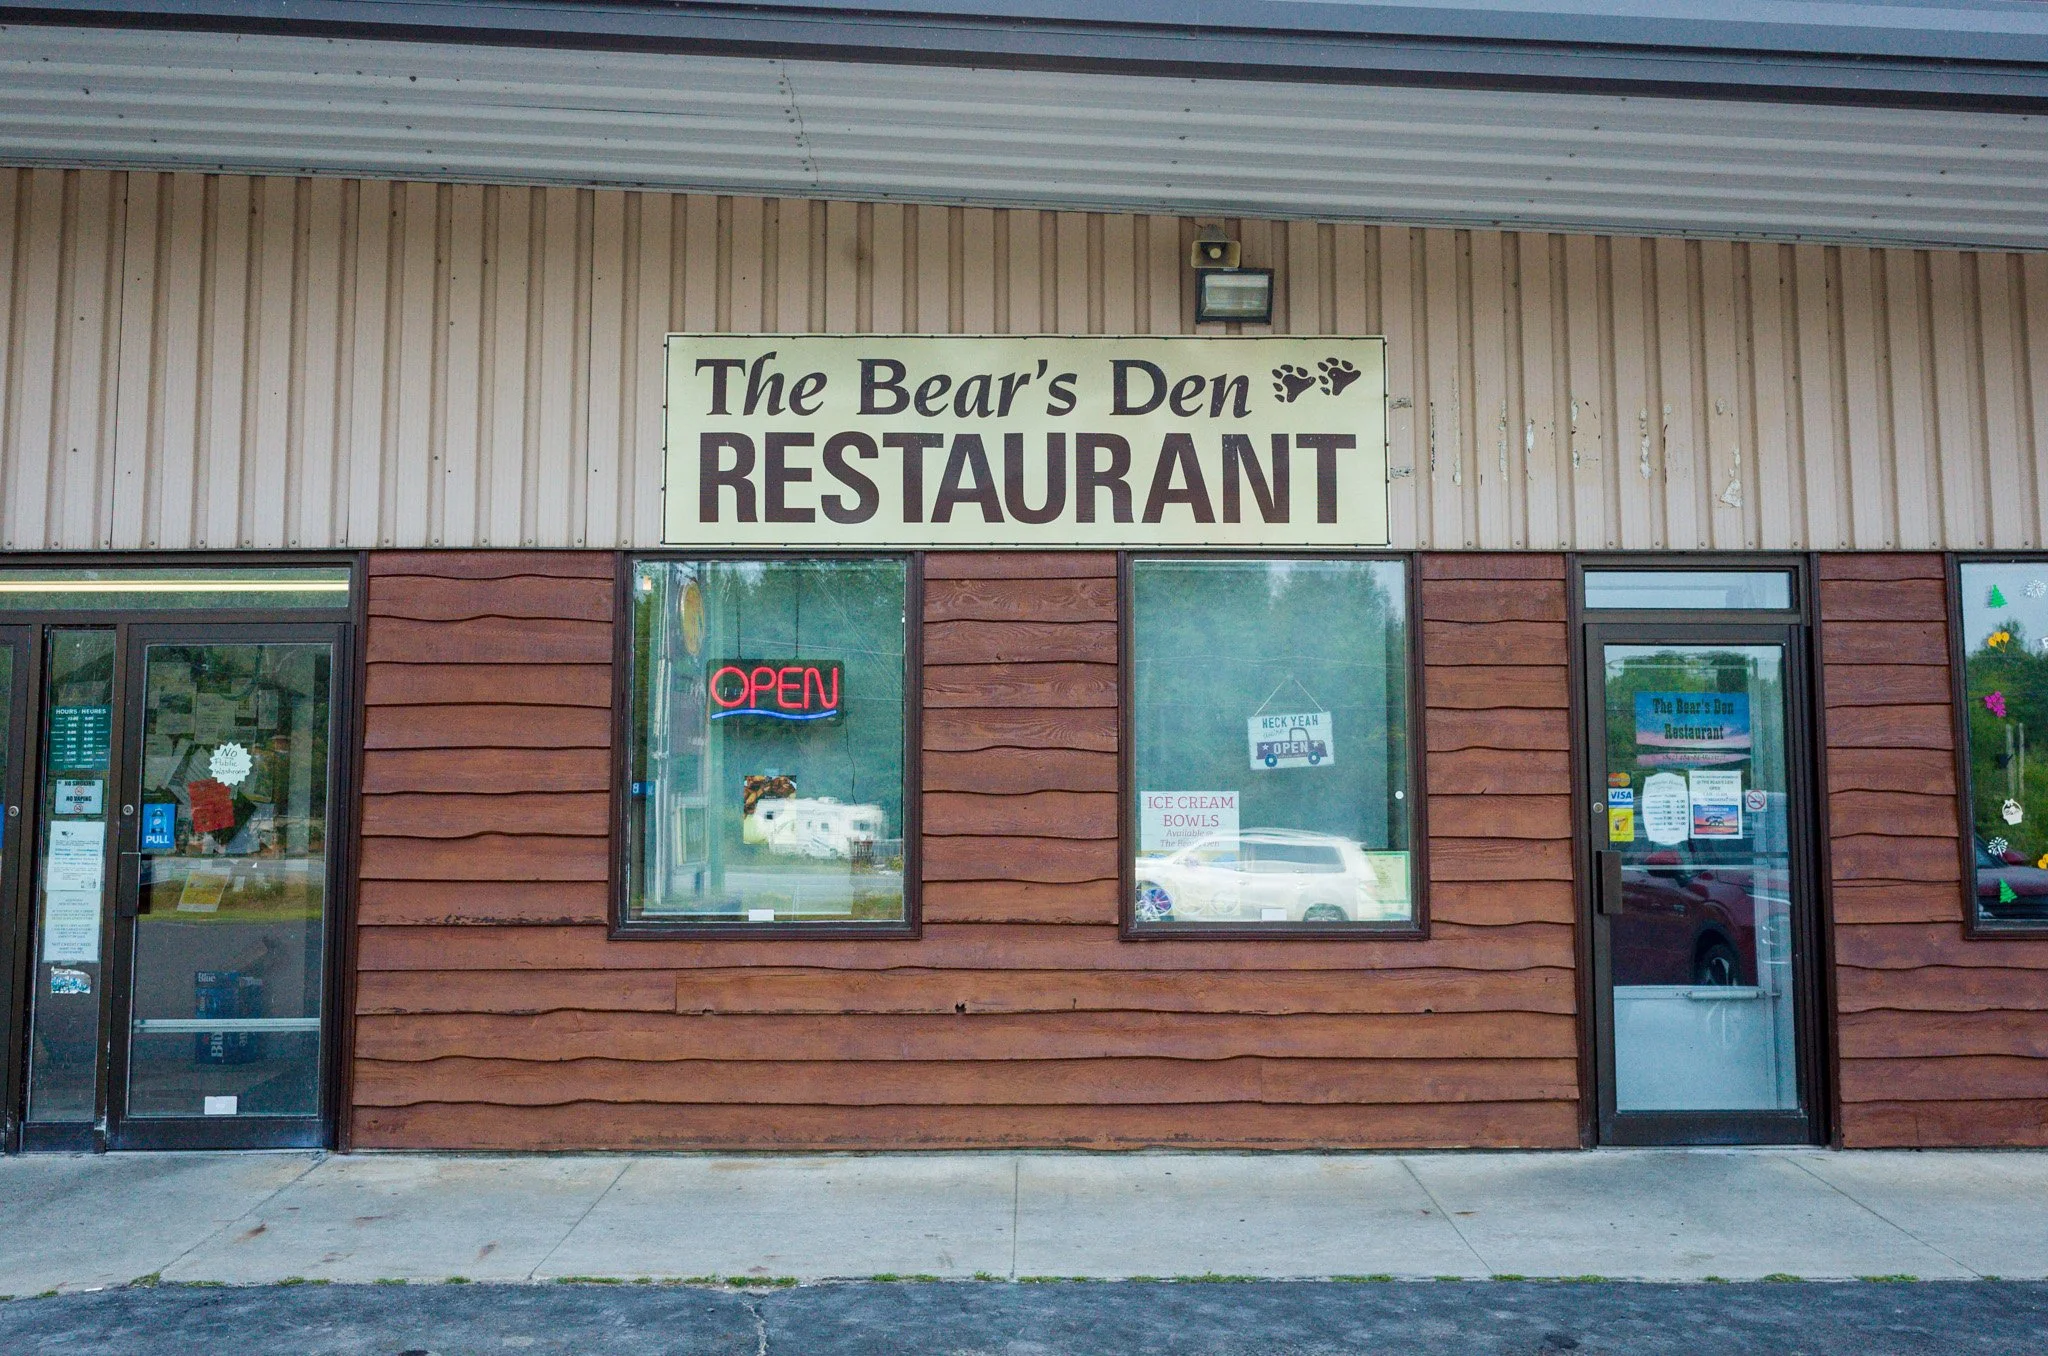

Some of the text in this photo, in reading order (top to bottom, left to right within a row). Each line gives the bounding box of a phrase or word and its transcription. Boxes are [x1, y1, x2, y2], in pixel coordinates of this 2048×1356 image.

[695, 351, 1253, 418] The Bear's Den
[699, 431, 1357, 525] RESTAURANT
[710, 666, 838, 709] OPEN
[1653, 698, 1735, 715] The Bear's Den
[1262, 714, 1319, 729] HECK YEAH
[1664, 723, 1724, 740] Restaurant
[221, 748, 238, 758] No
[1273, 741, 1309, 755] OPEN
[1611, 791, 1632, 799] VISA
[1148, 796, 1234, 809] ICE CREAM
[1163, 814, 1219, 827] BOWLS
[145, 835, 170, 844] PULL
[1166, 829, 1204, 837] Available
[198, 972, 216, 982] Blue
